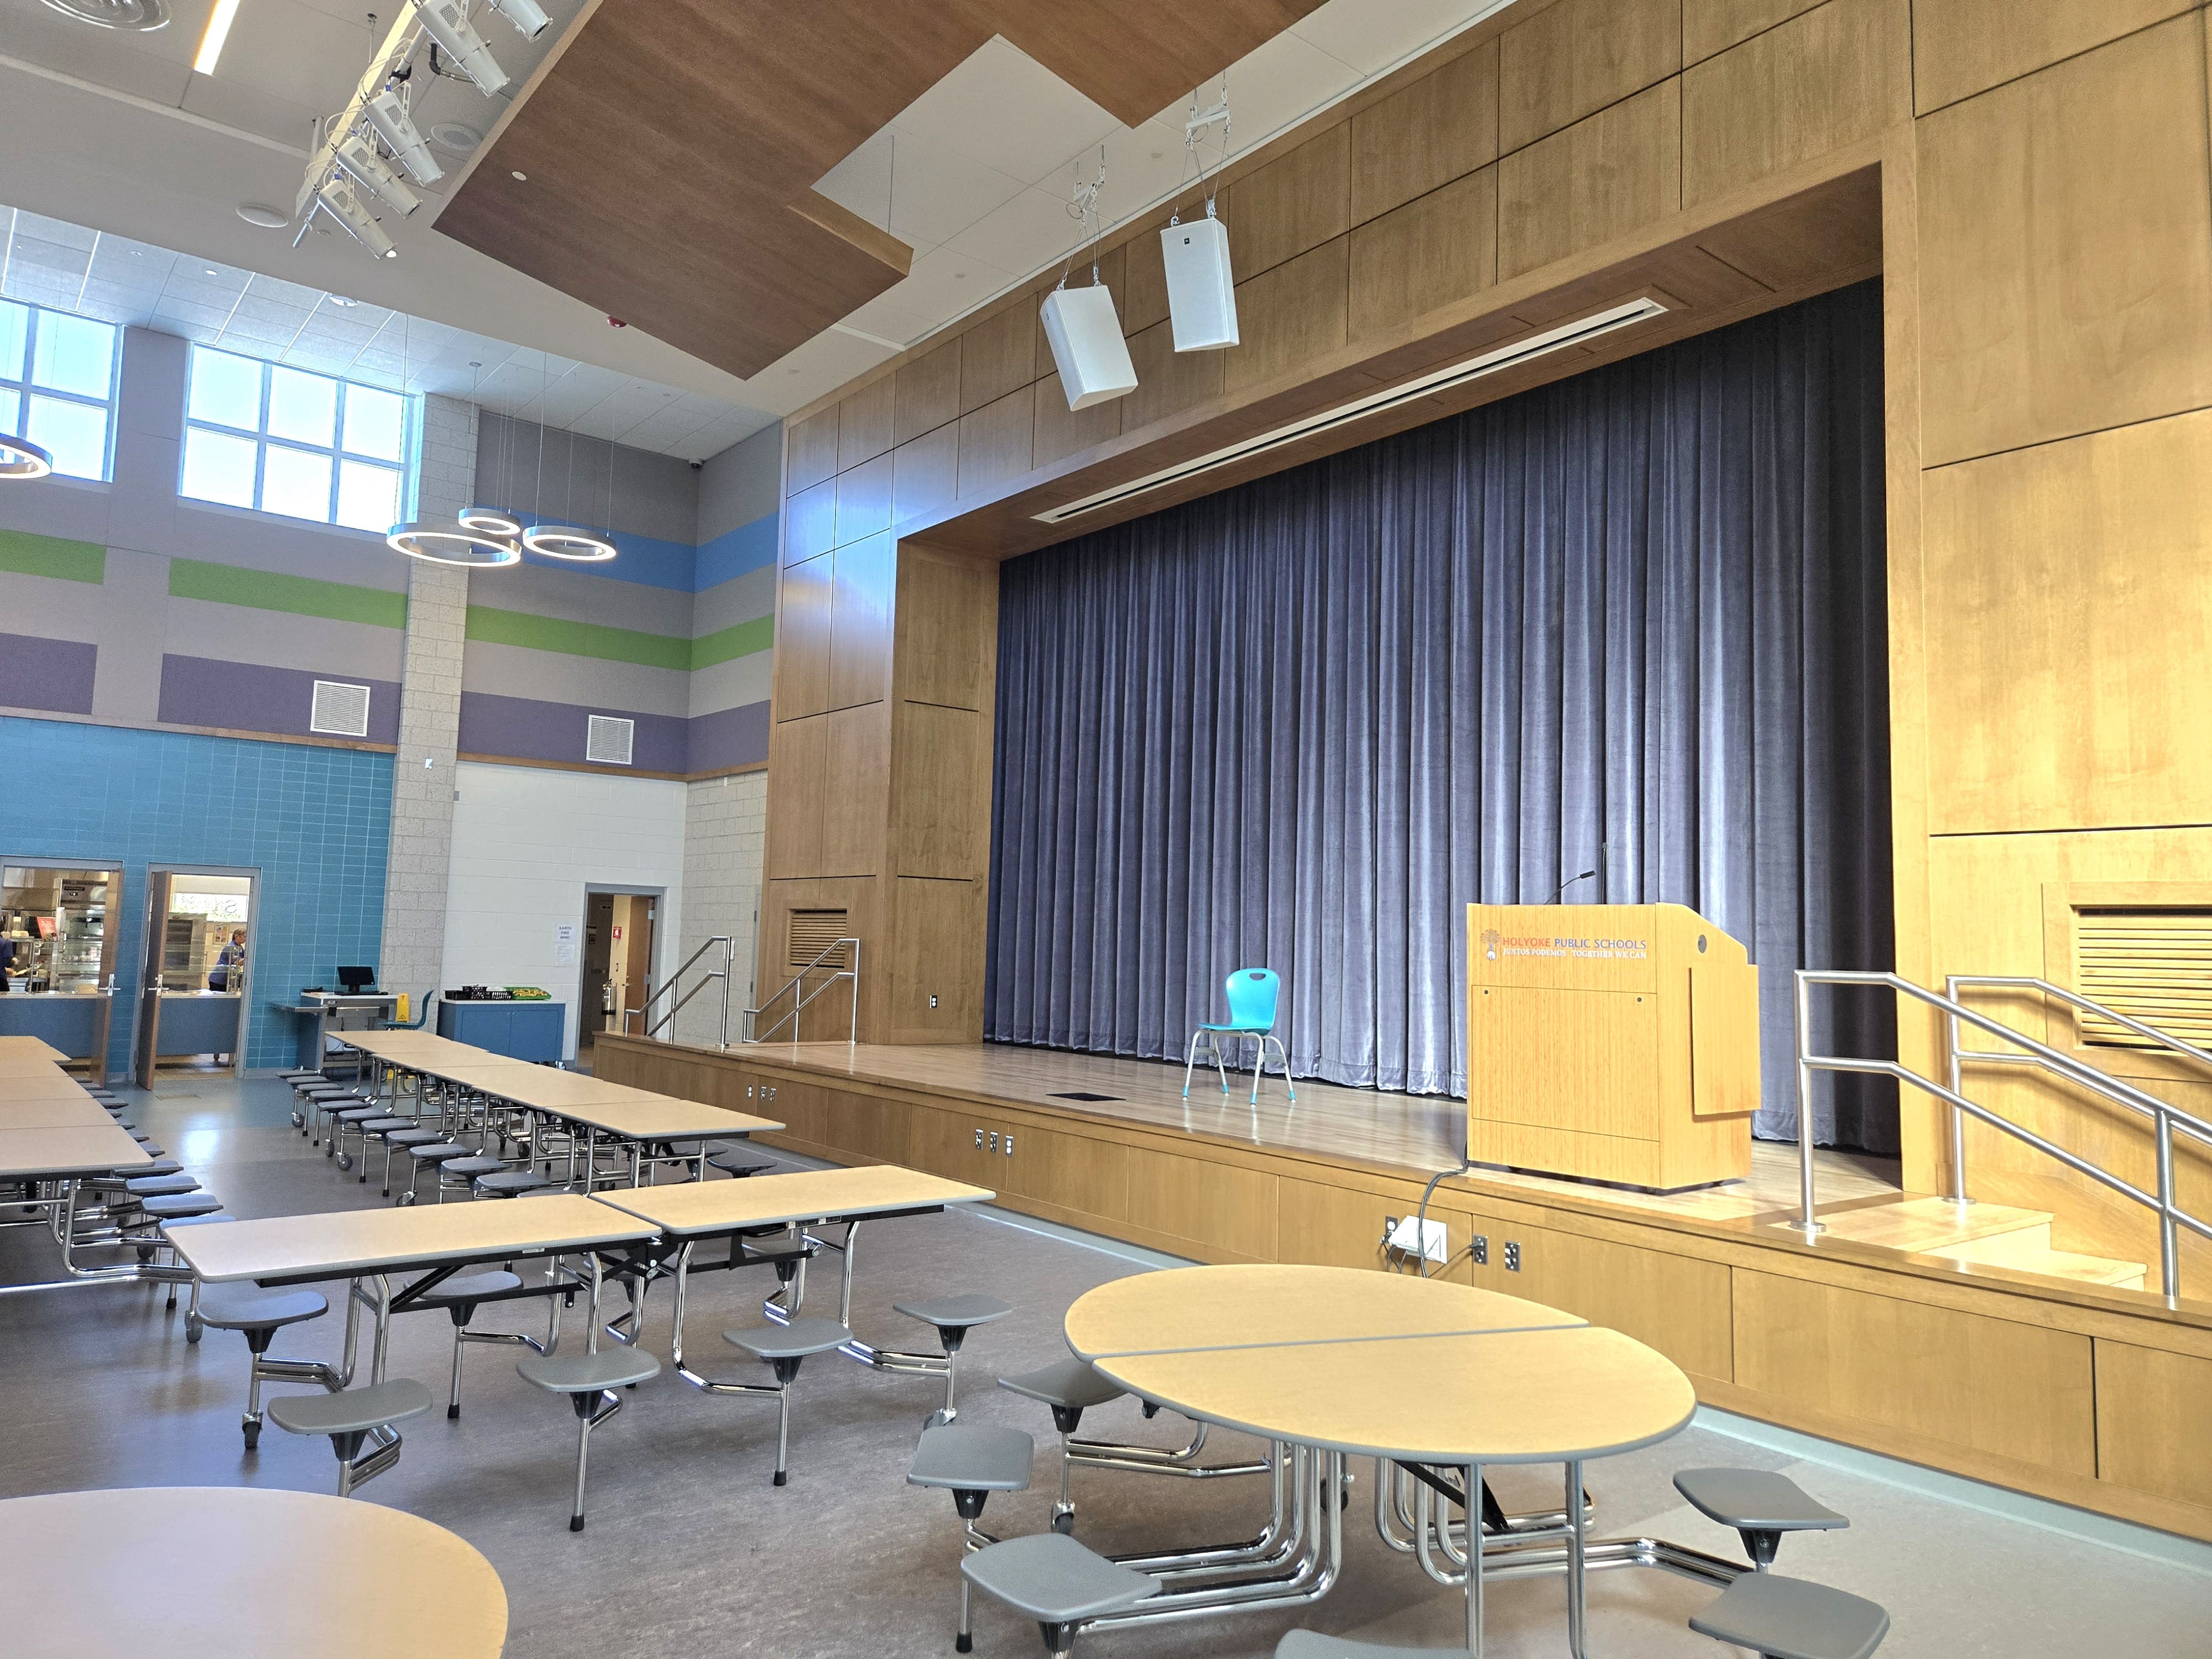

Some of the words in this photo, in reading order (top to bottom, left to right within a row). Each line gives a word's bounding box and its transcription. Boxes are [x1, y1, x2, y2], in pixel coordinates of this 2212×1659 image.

[1503, 937, 1551, 947] HOLYOKE
[1554, 938, 1590, 948] PUBLIC
[1594, 939, 1646, 950] SCHOOLS
